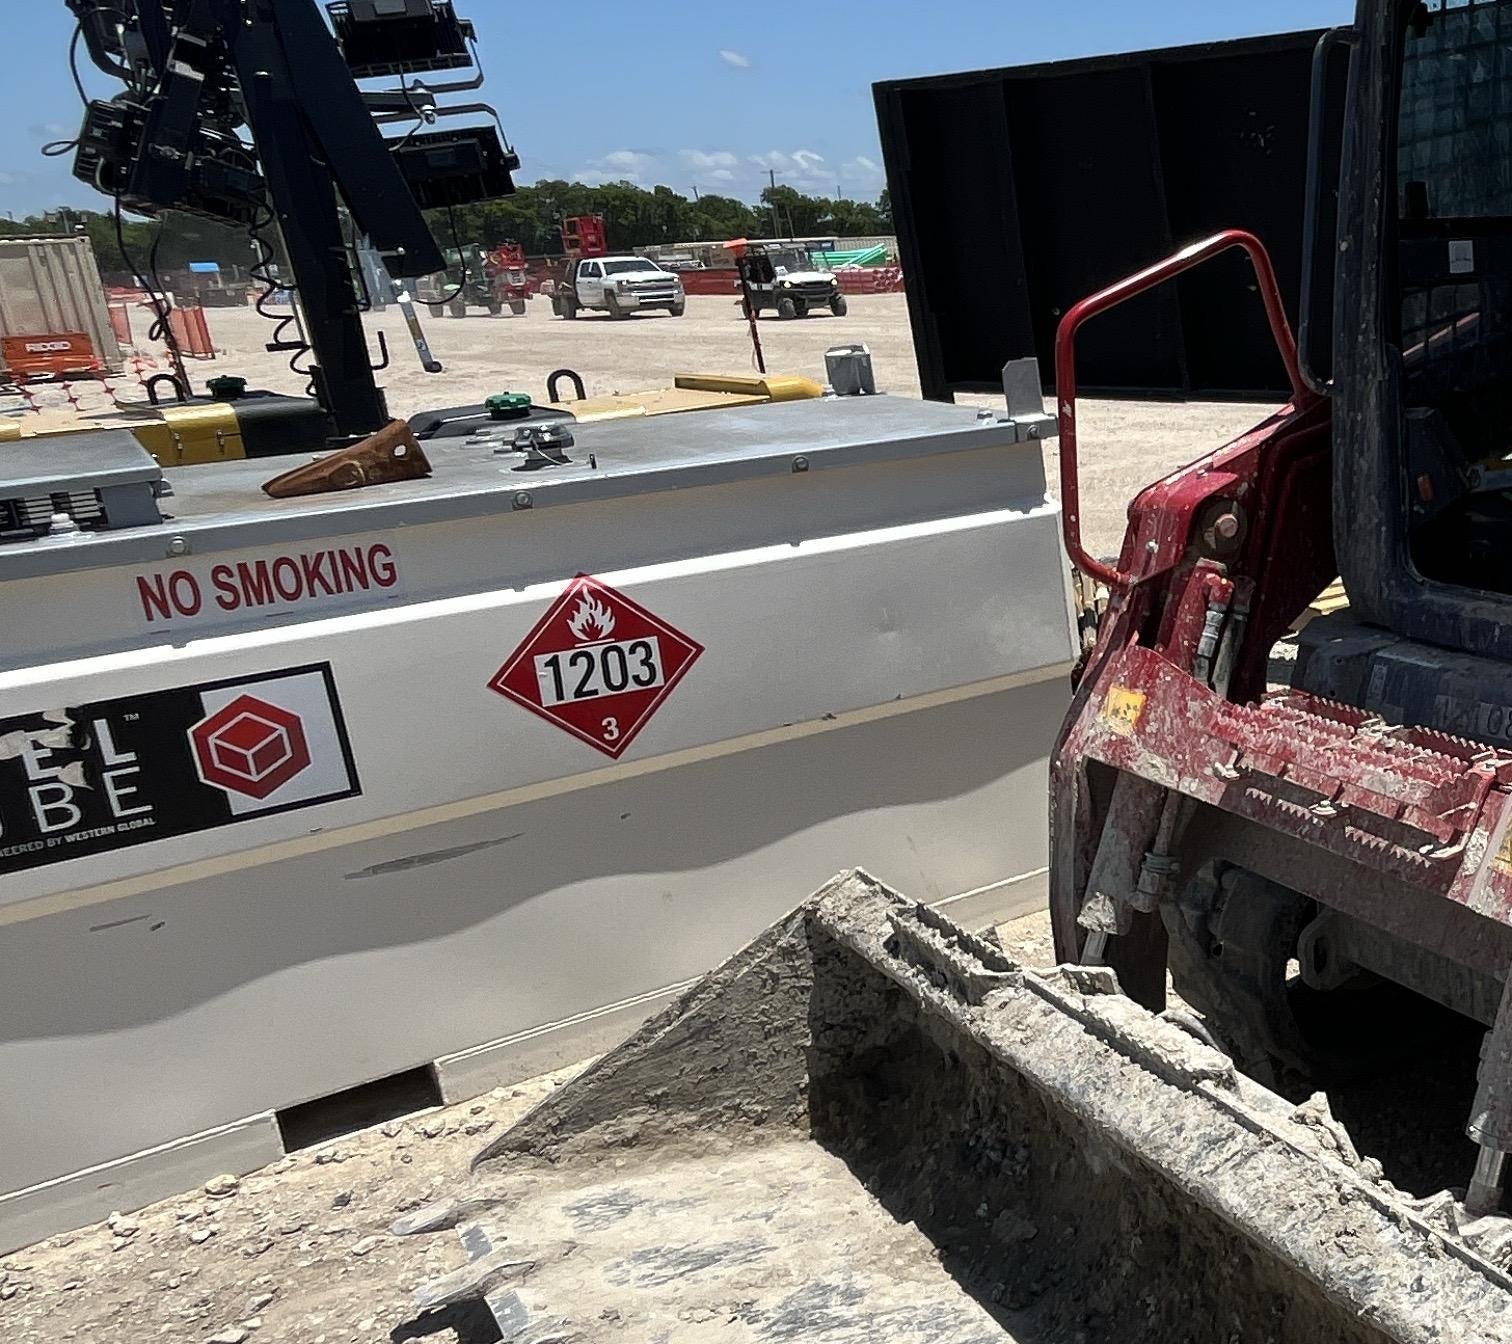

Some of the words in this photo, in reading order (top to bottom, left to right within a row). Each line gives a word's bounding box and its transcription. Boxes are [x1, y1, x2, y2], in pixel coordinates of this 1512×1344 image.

[136, 570, 202, 622] NO
[210, 543, 398, 611] SMOKING
[544, 640, 658, 702] 1203
[601, 716, 620, 741] 3
[0, 765, 153, 838] BE
[0, 840, 44, 857] EERED
[47, 836, 62, 848] BY
[64, 825, 115, 843] WESTERN
[117, 817, 156, 832] GLOBAL
